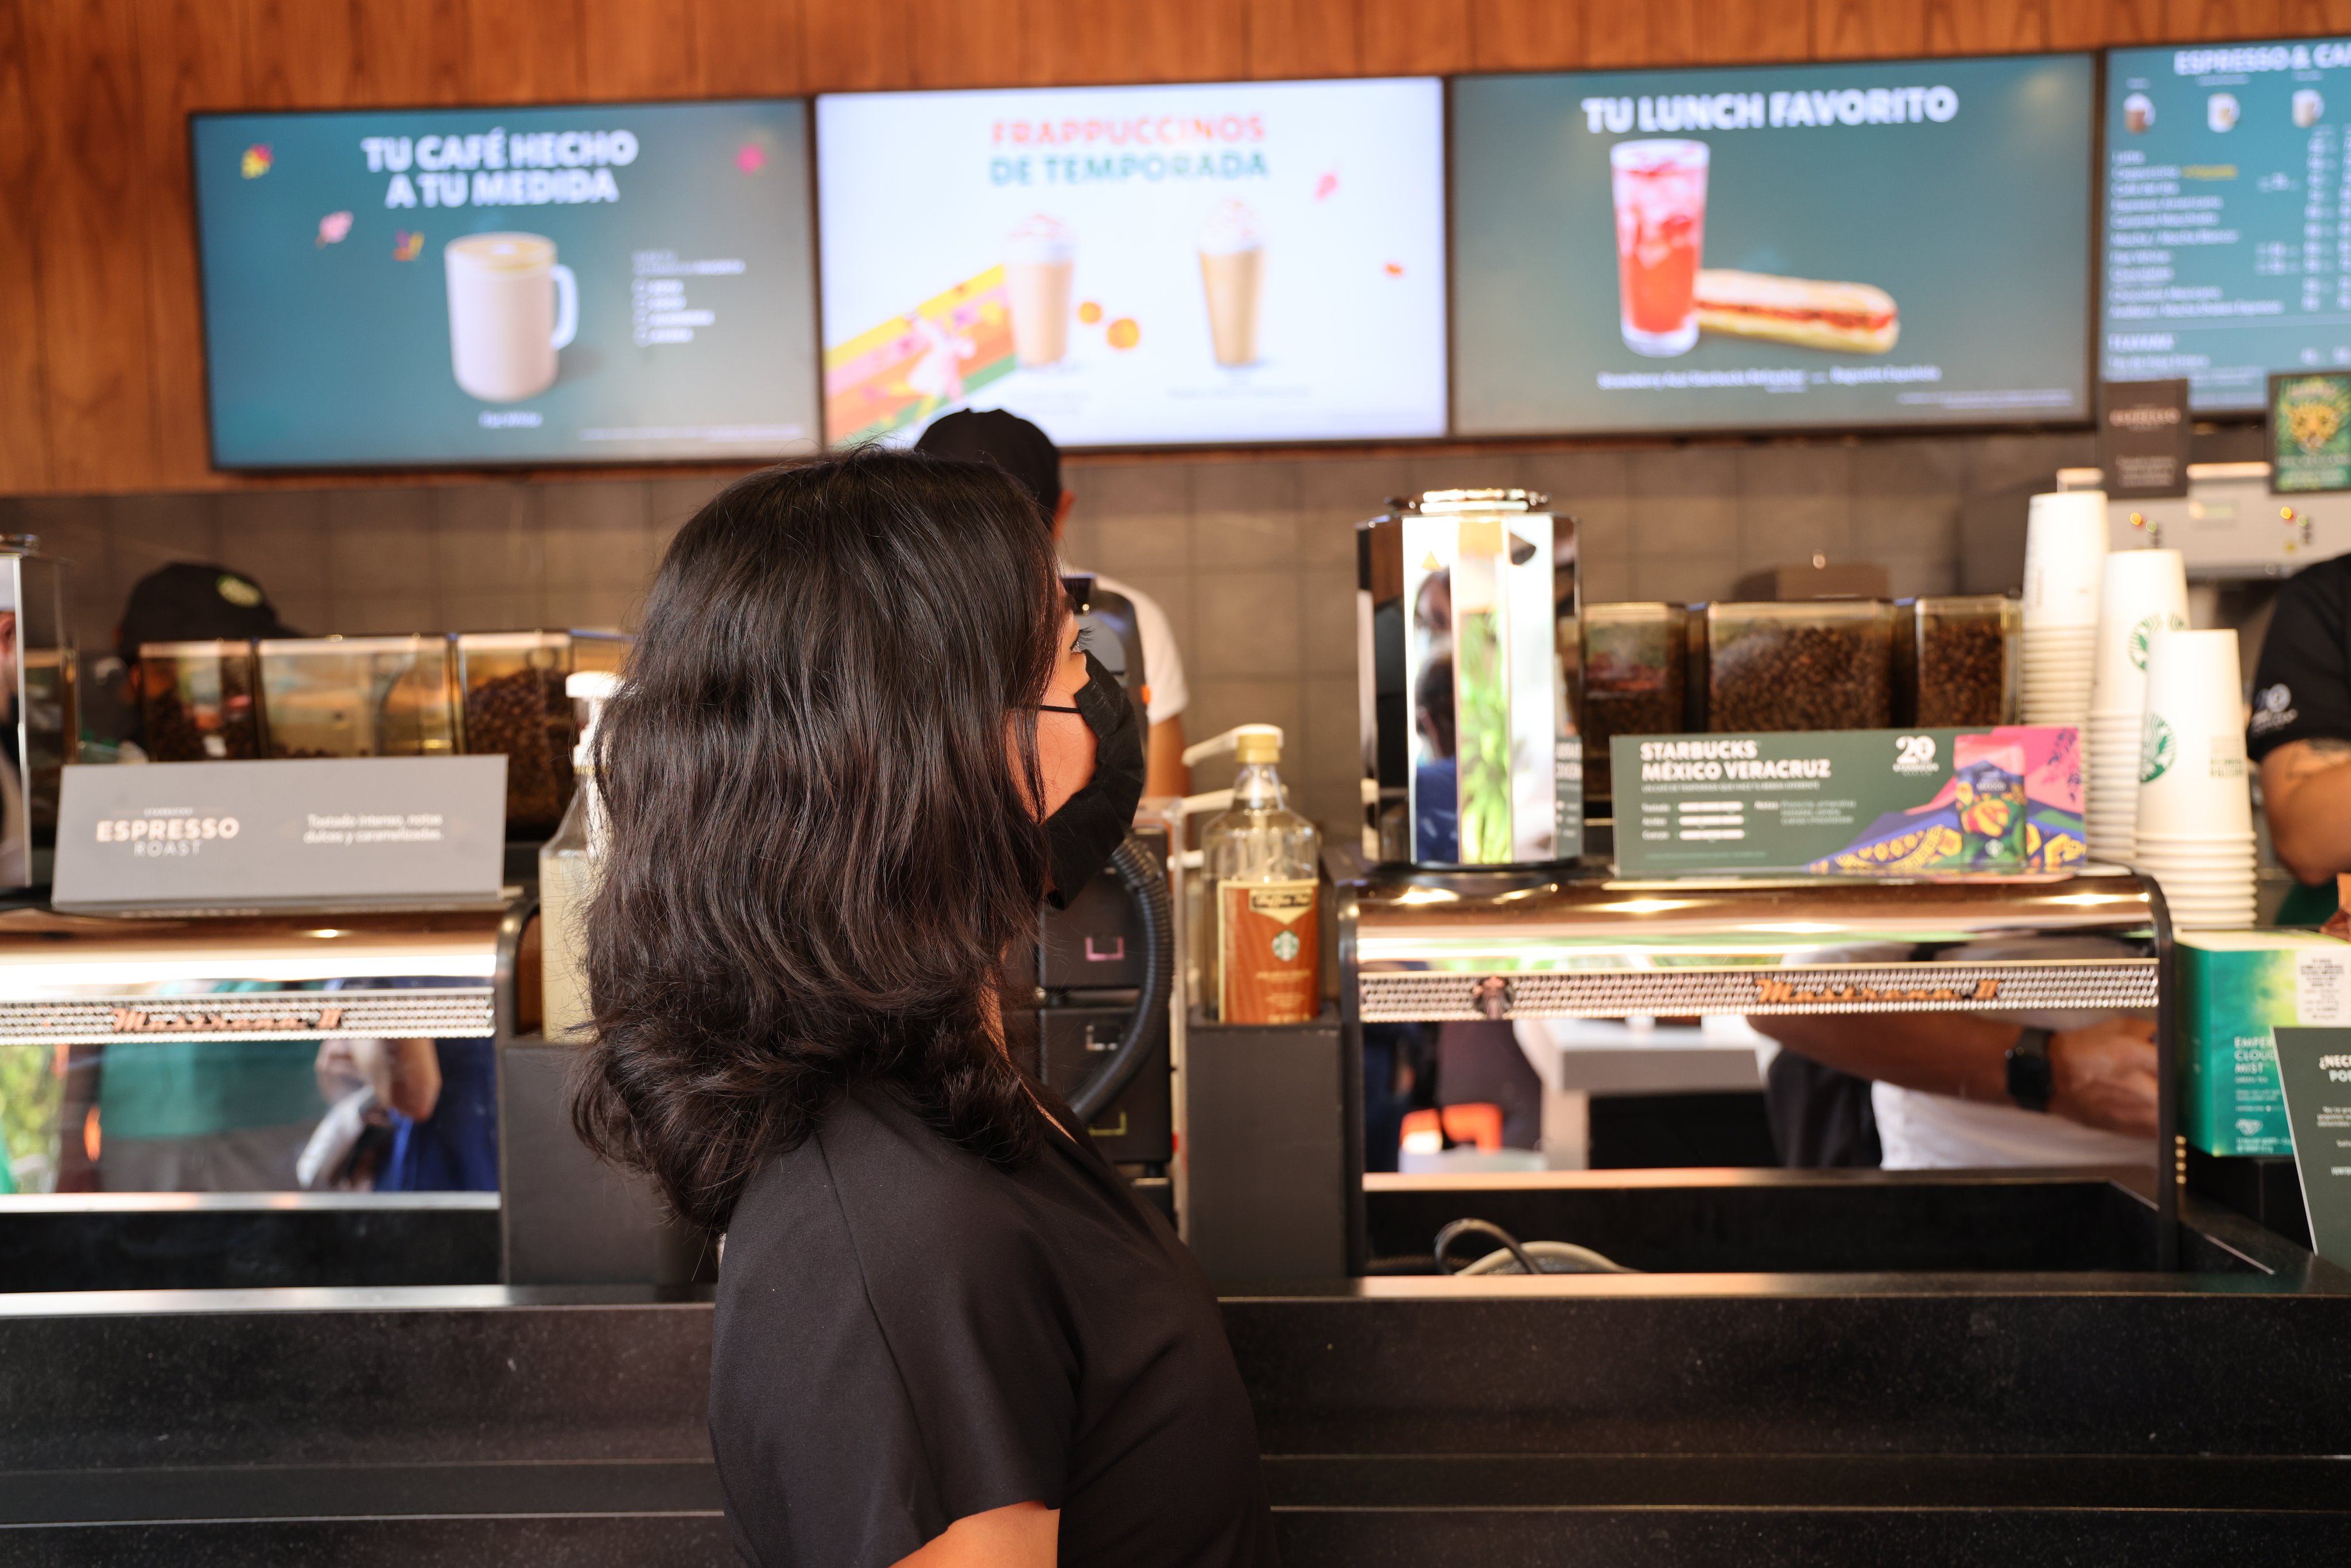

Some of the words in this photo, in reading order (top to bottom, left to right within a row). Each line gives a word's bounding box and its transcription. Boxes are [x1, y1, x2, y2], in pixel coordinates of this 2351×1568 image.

[2174, 46, 2290, 75] ESPRESSO
[1581, 96, 1634, 134] TU
[1637, 92, 1766, 133] LUNCH
[1769, 85, 1958, 127] FAVORITO
[991, 115, 1265, 147] FRAPPUCCINOS
[360, 135, 413, 172] TU
[414, 126, 507, 172] CAFÉ
[509, 130, 639, 169] HECHO
[990, 156, 1032, 187] DE
[1042, 150, 1269, 186] TEMPORADA
[384, 173, 418, 209] A
[417, 172, 470, 208] TU
[471, 168, 620, 207] MEDIDA
[1640, 740, 1758, 760] STARBUCKS
[1641, 759, 1722, 781] MÉXICO
[1723, 759, 1832, 780] VERACRUZ
[96, 817, 240, 843] ESPRESSO
[306, 813, 356, 829] Tostado
[406, 812, 444, 828] notas
[133, 839, 204, 858] ROAST
[302, 829, 345, 845] dulces
[344, 830, 355, 847] y
[2234, 1062, 2264, 1074] MIST
